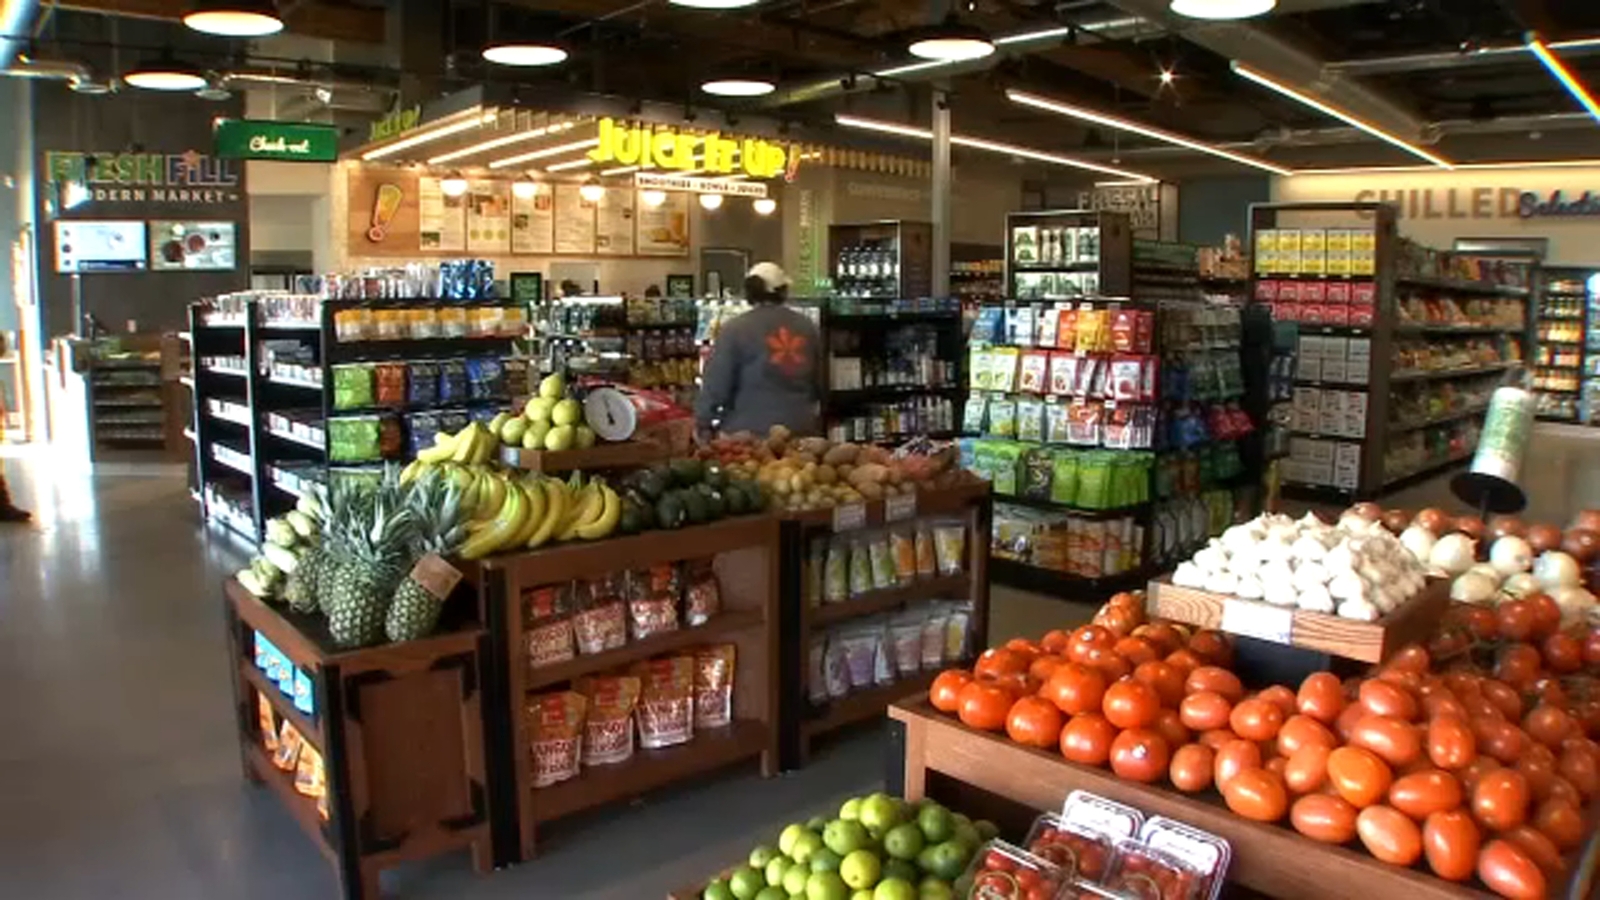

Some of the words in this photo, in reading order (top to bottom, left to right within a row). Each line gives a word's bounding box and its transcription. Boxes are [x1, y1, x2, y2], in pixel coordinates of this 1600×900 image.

[588, 117, 699, 171] JUICE
[703, 134, 738, 173] IT
[152, 190, 224, 202] MARKET
